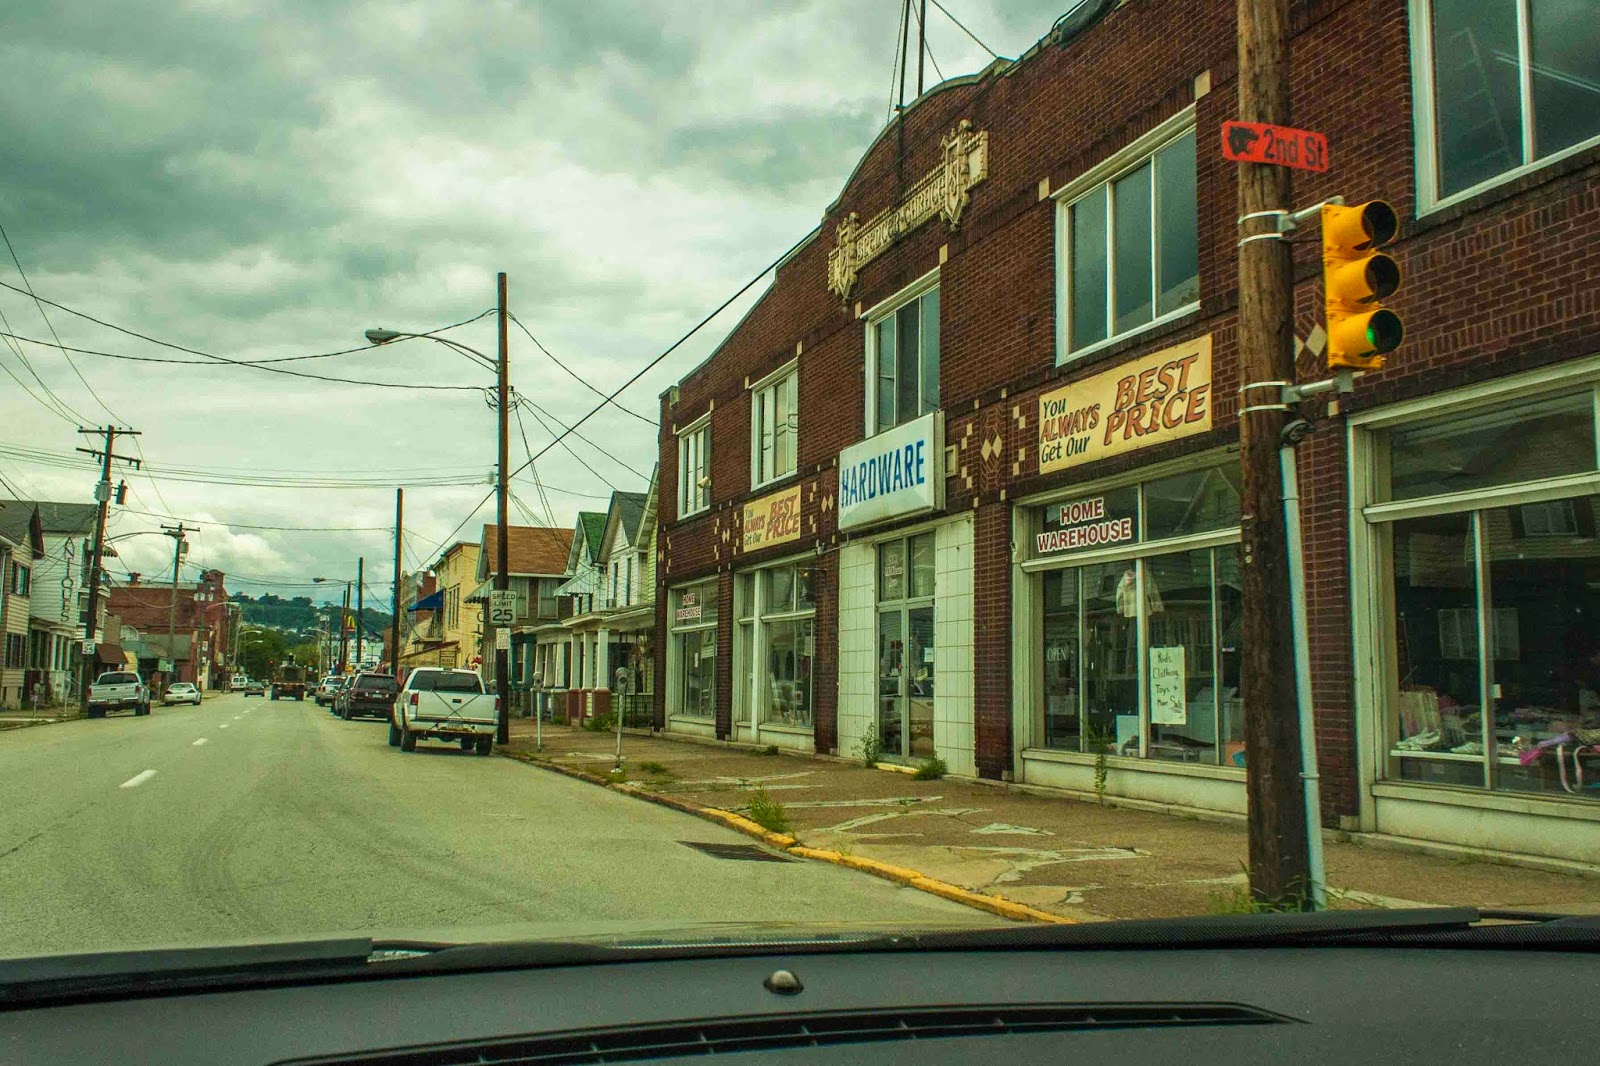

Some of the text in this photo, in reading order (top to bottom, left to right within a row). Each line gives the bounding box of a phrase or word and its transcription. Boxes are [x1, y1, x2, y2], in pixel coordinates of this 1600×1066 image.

[1263, 129, 1323, 169] 2nd St
[857, 211, 900, 262] SPENCER
[1114, 352, 1199, 412] BEST
[1043, 398, 1066, 418] You
[1103, 383, 1210, 446] PRICE
[1040, 403, 1100, 444] ALWAYS
[1041, 436, 1091, 464] Get Our
[841, 440, 925, 508] HARDWARE
[770, 494, 798, 521] BEST
[1060, 497, 1104, 526] HOME
[766, 512, 800, 541] PRICE
[1037, 517, 1132, 553] WAREHOUSE
[676, 606, 701, 621] WAREHOUSE
[682, 593, 696, 606] HOME
[492, 608, 513, 622] 25
[1047, 645, 1069, 661] OPEN
[1157, 652, 1171, 663] Kids
[1153, 667, 1178, 680] Clothing
[1155, 684, 1170, 696] Toys
